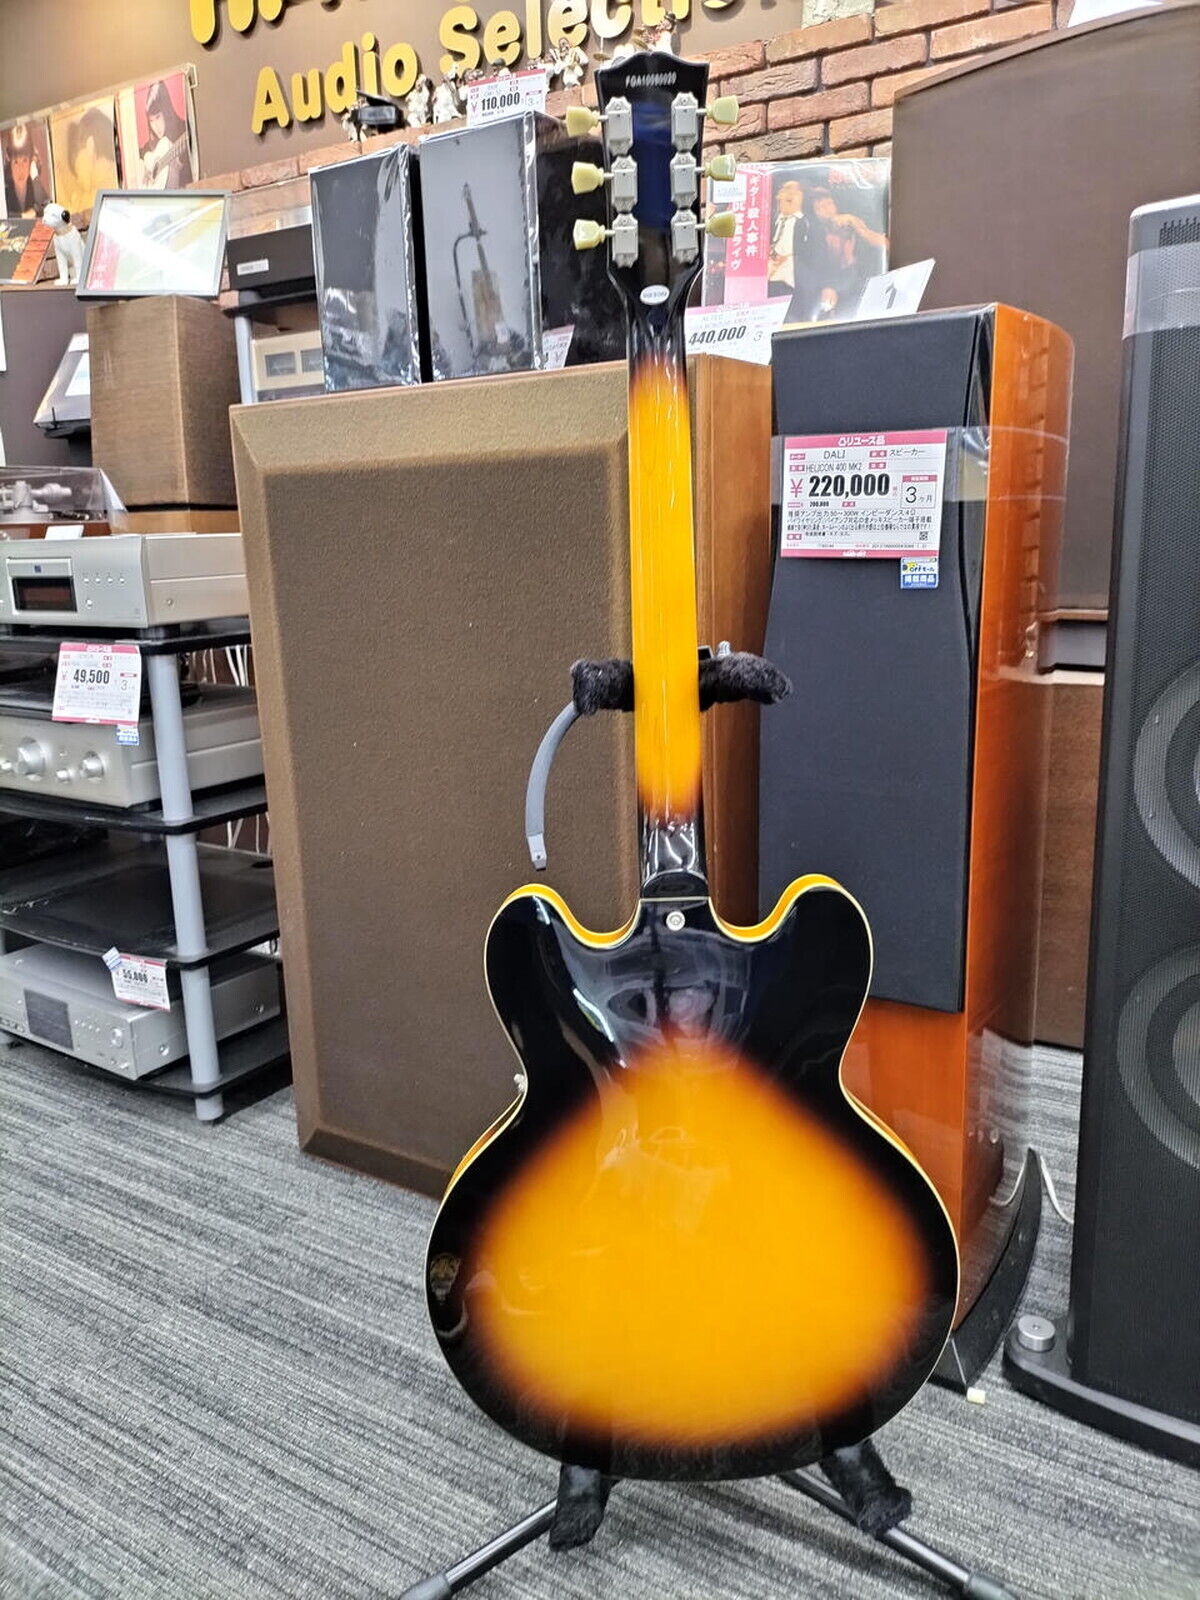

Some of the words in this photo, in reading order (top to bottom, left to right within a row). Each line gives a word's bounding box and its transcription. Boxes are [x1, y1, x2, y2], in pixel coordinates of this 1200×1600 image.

[251, 32, 418, 135] Audio
[481, 92, 520, 110] 110,000
[688, 325, 747, 345] 440,000
[823, 450, 846, 460] DALI
[808, 473, 890, 499] 220,000
[73, 669, 110, 685] 49,500
